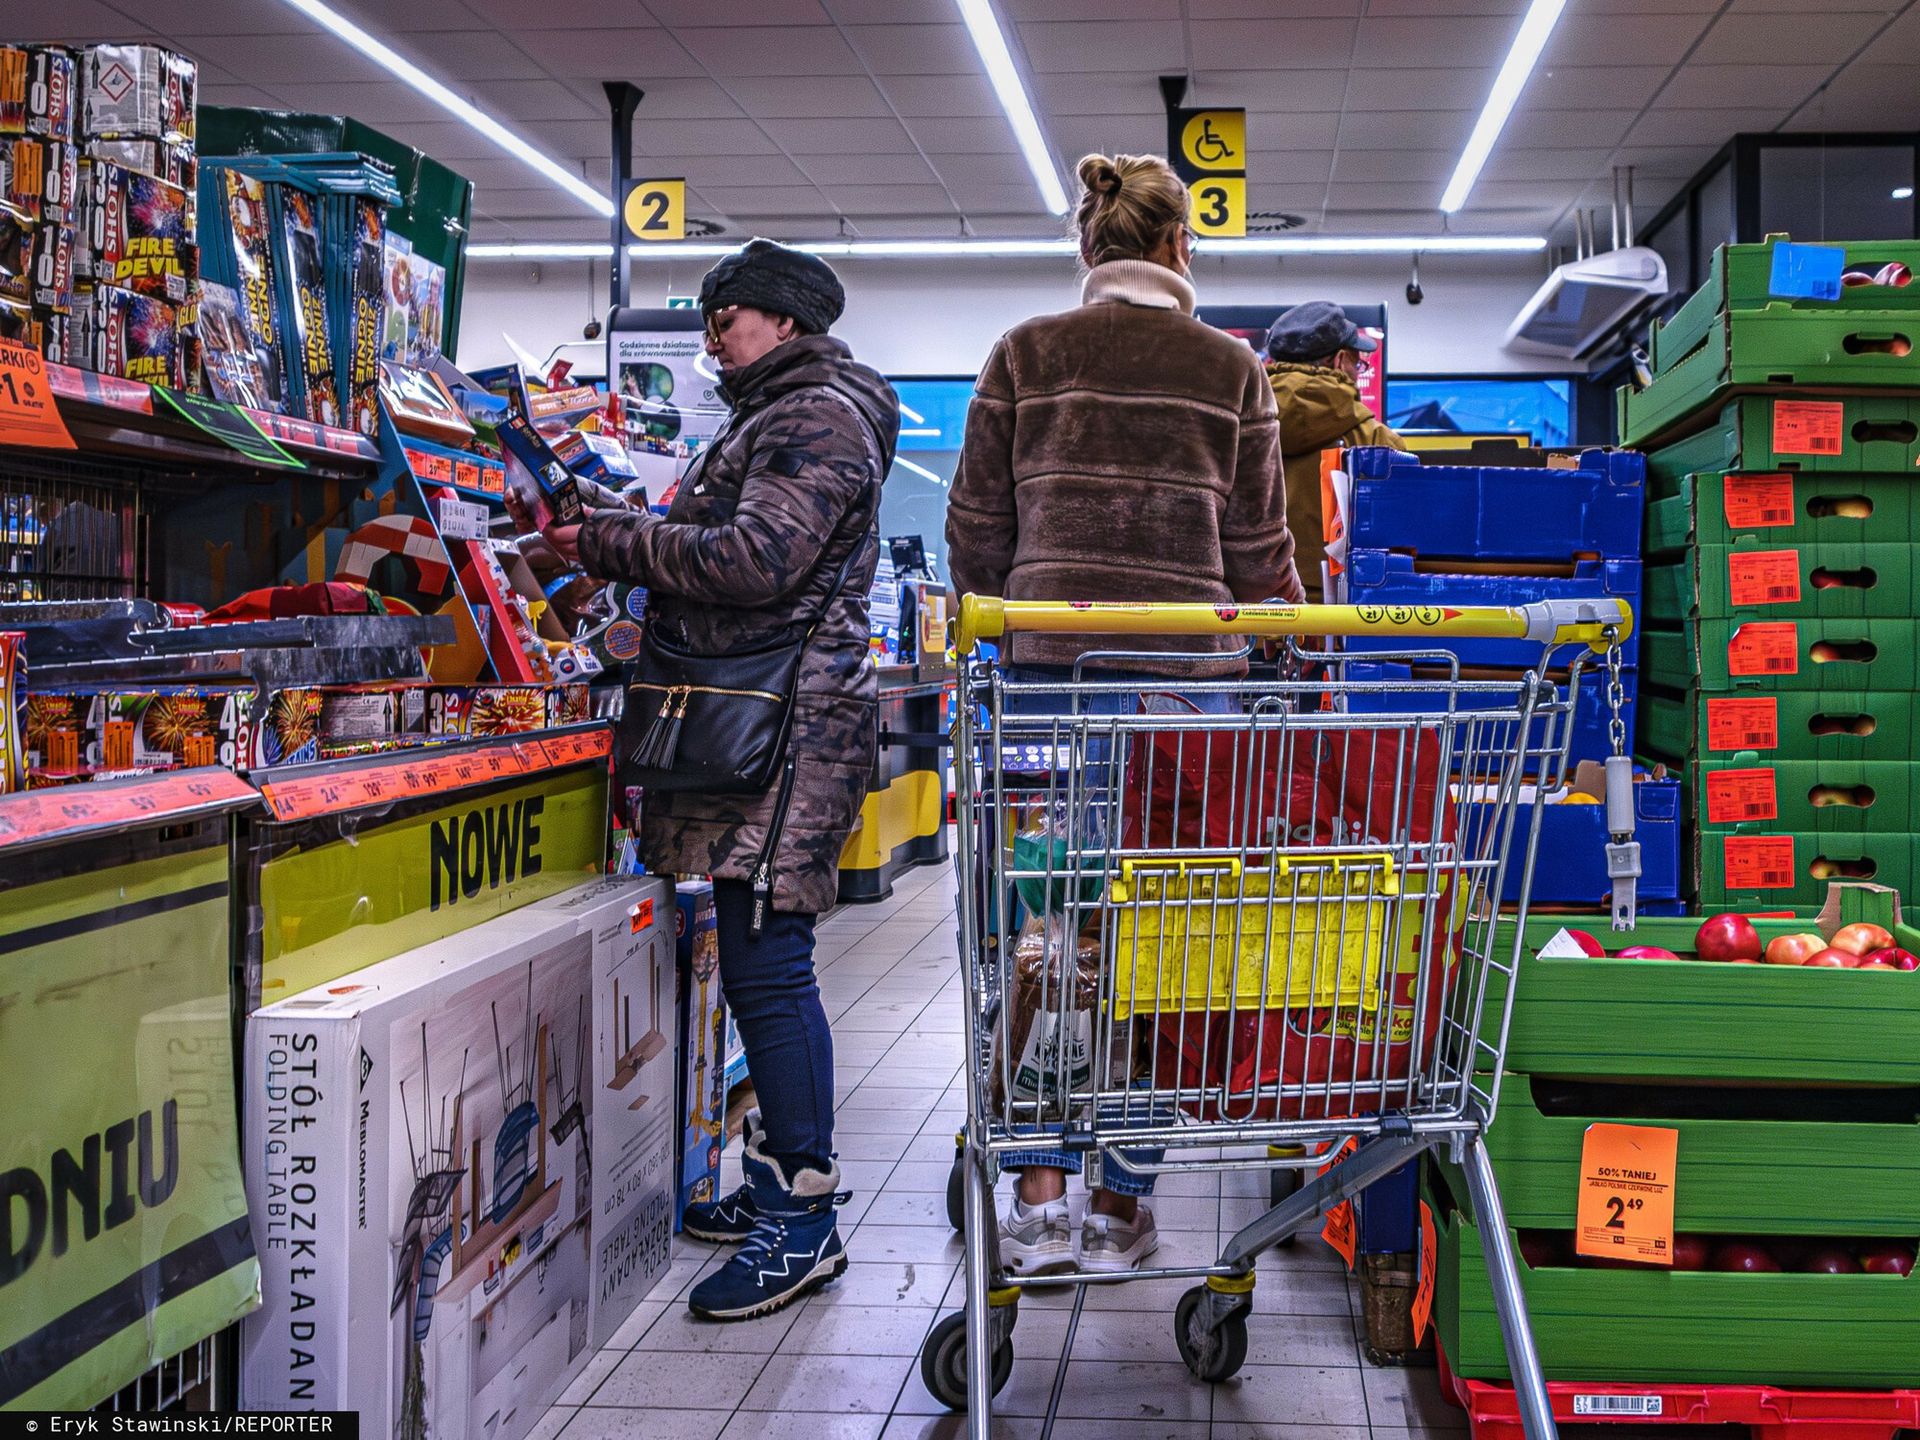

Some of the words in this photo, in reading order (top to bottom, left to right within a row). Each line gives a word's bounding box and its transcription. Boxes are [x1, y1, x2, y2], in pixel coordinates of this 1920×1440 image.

[50, 57, 63, 117] SHOTS
[107, 165, 118, 253] SHOTS
[641, 191, 670, 231] 2
[1200, 187, 1229, 226] 3
[55, 228, 67, 289] SHOTS
[115, 257, 185, 280] DEVIL
[126, 237, 176, 257] FIRE
[0, 349, 24, 369] RKI
[107, 287, 118, 376] SHOTS
[125, 356, 167, 378] FIRE
[301, 286, 319, 376] OGNIE
[313, 296, 328, 373] ZIMNE
[355, 297, 367, 384] OGNIE
[366, 306, 377, 380] ZIMNE
[431, 795, 543, 911] NOWE
[268, 1034, 288, 1154] FOLDING
[291, 1033, 323, 1133] STÓŁ
[0, 1098, 179, 1289] DNIU
[358, 1100, 370, 1229] MEBLOMASTER
[1598, 1167, 1620, 1178] 50%
[1622, 1169, 1656, 1181] TANIEJ
[268, 1168, 287, 1249] TABLE
[1605, 1196, 1625, 1229] 2
[1627, 1198, 1643, 1210] 49
[289, 1156, 317, 1411] ROZKŁADAN
